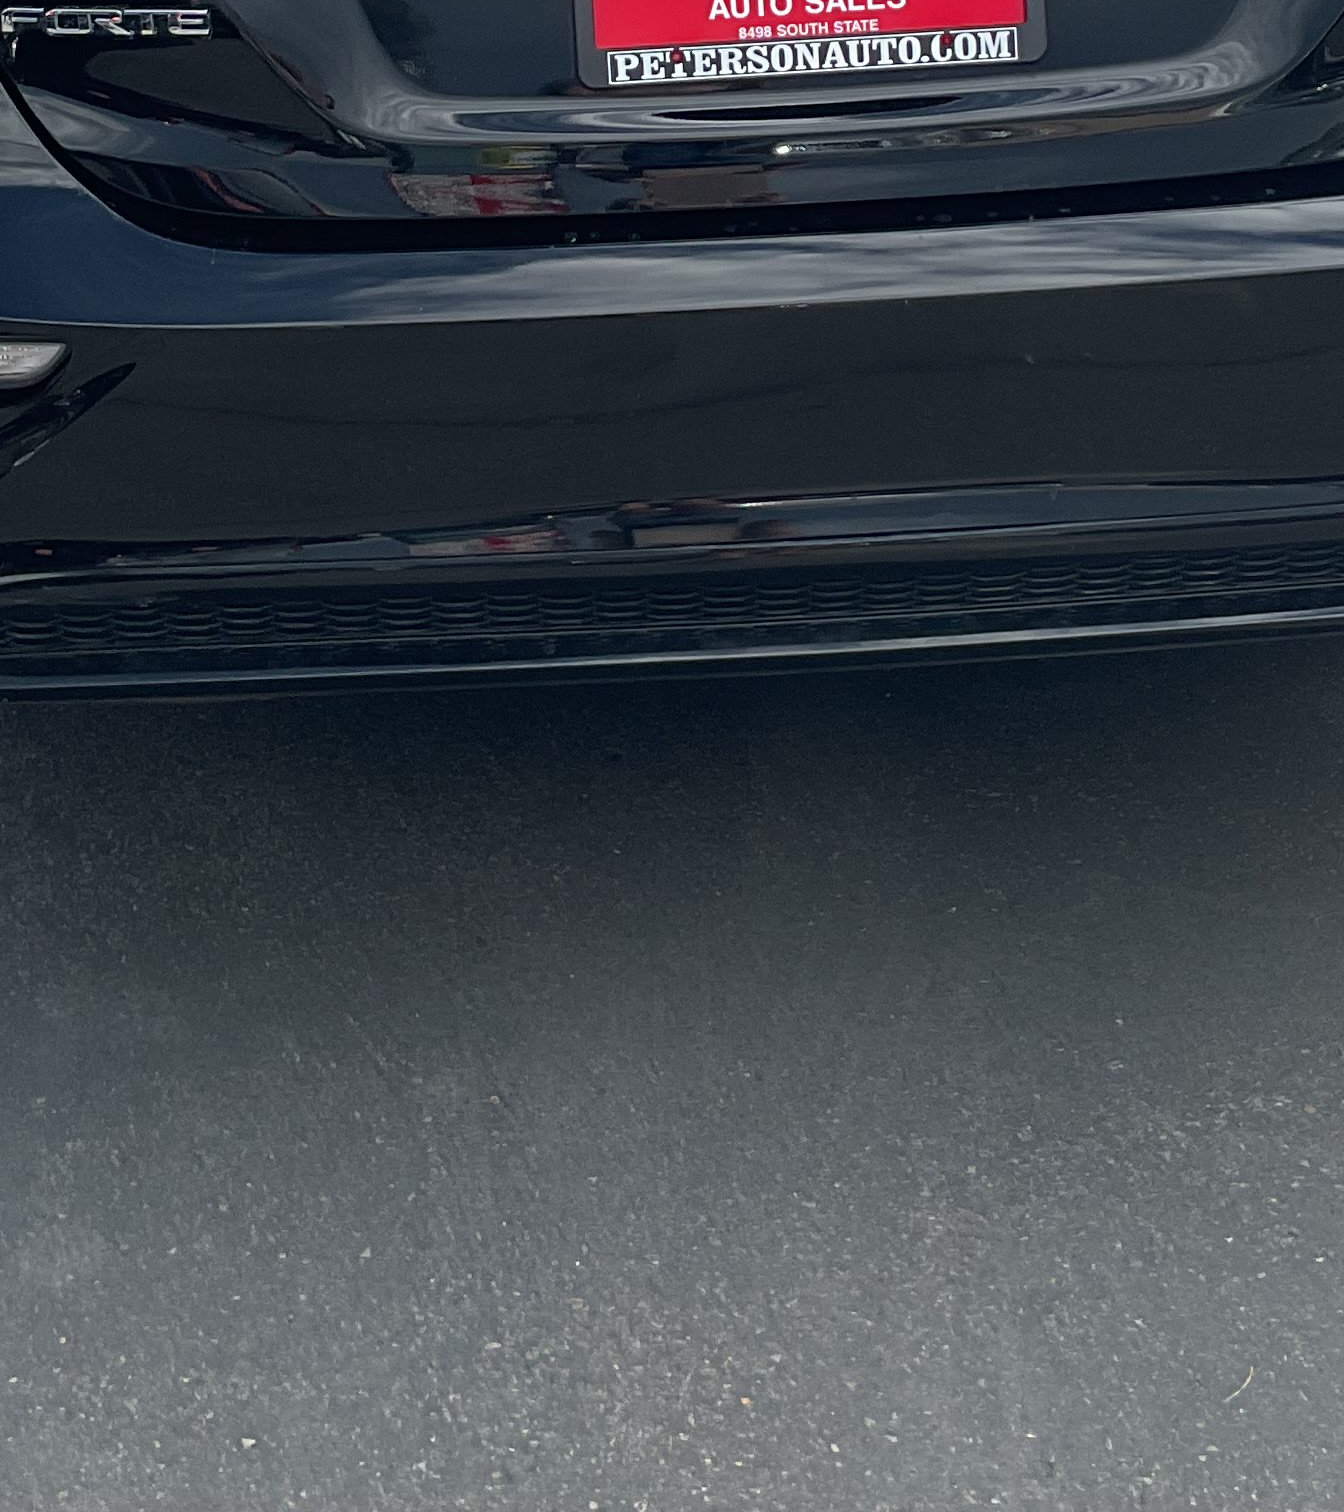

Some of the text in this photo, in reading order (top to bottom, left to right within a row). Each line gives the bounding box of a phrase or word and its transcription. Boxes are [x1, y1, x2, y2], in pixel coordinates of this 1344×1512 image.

[1, 7, 211, 36] FORTE
[738, 19, 879, 40] 8498 SOUTH STATE
